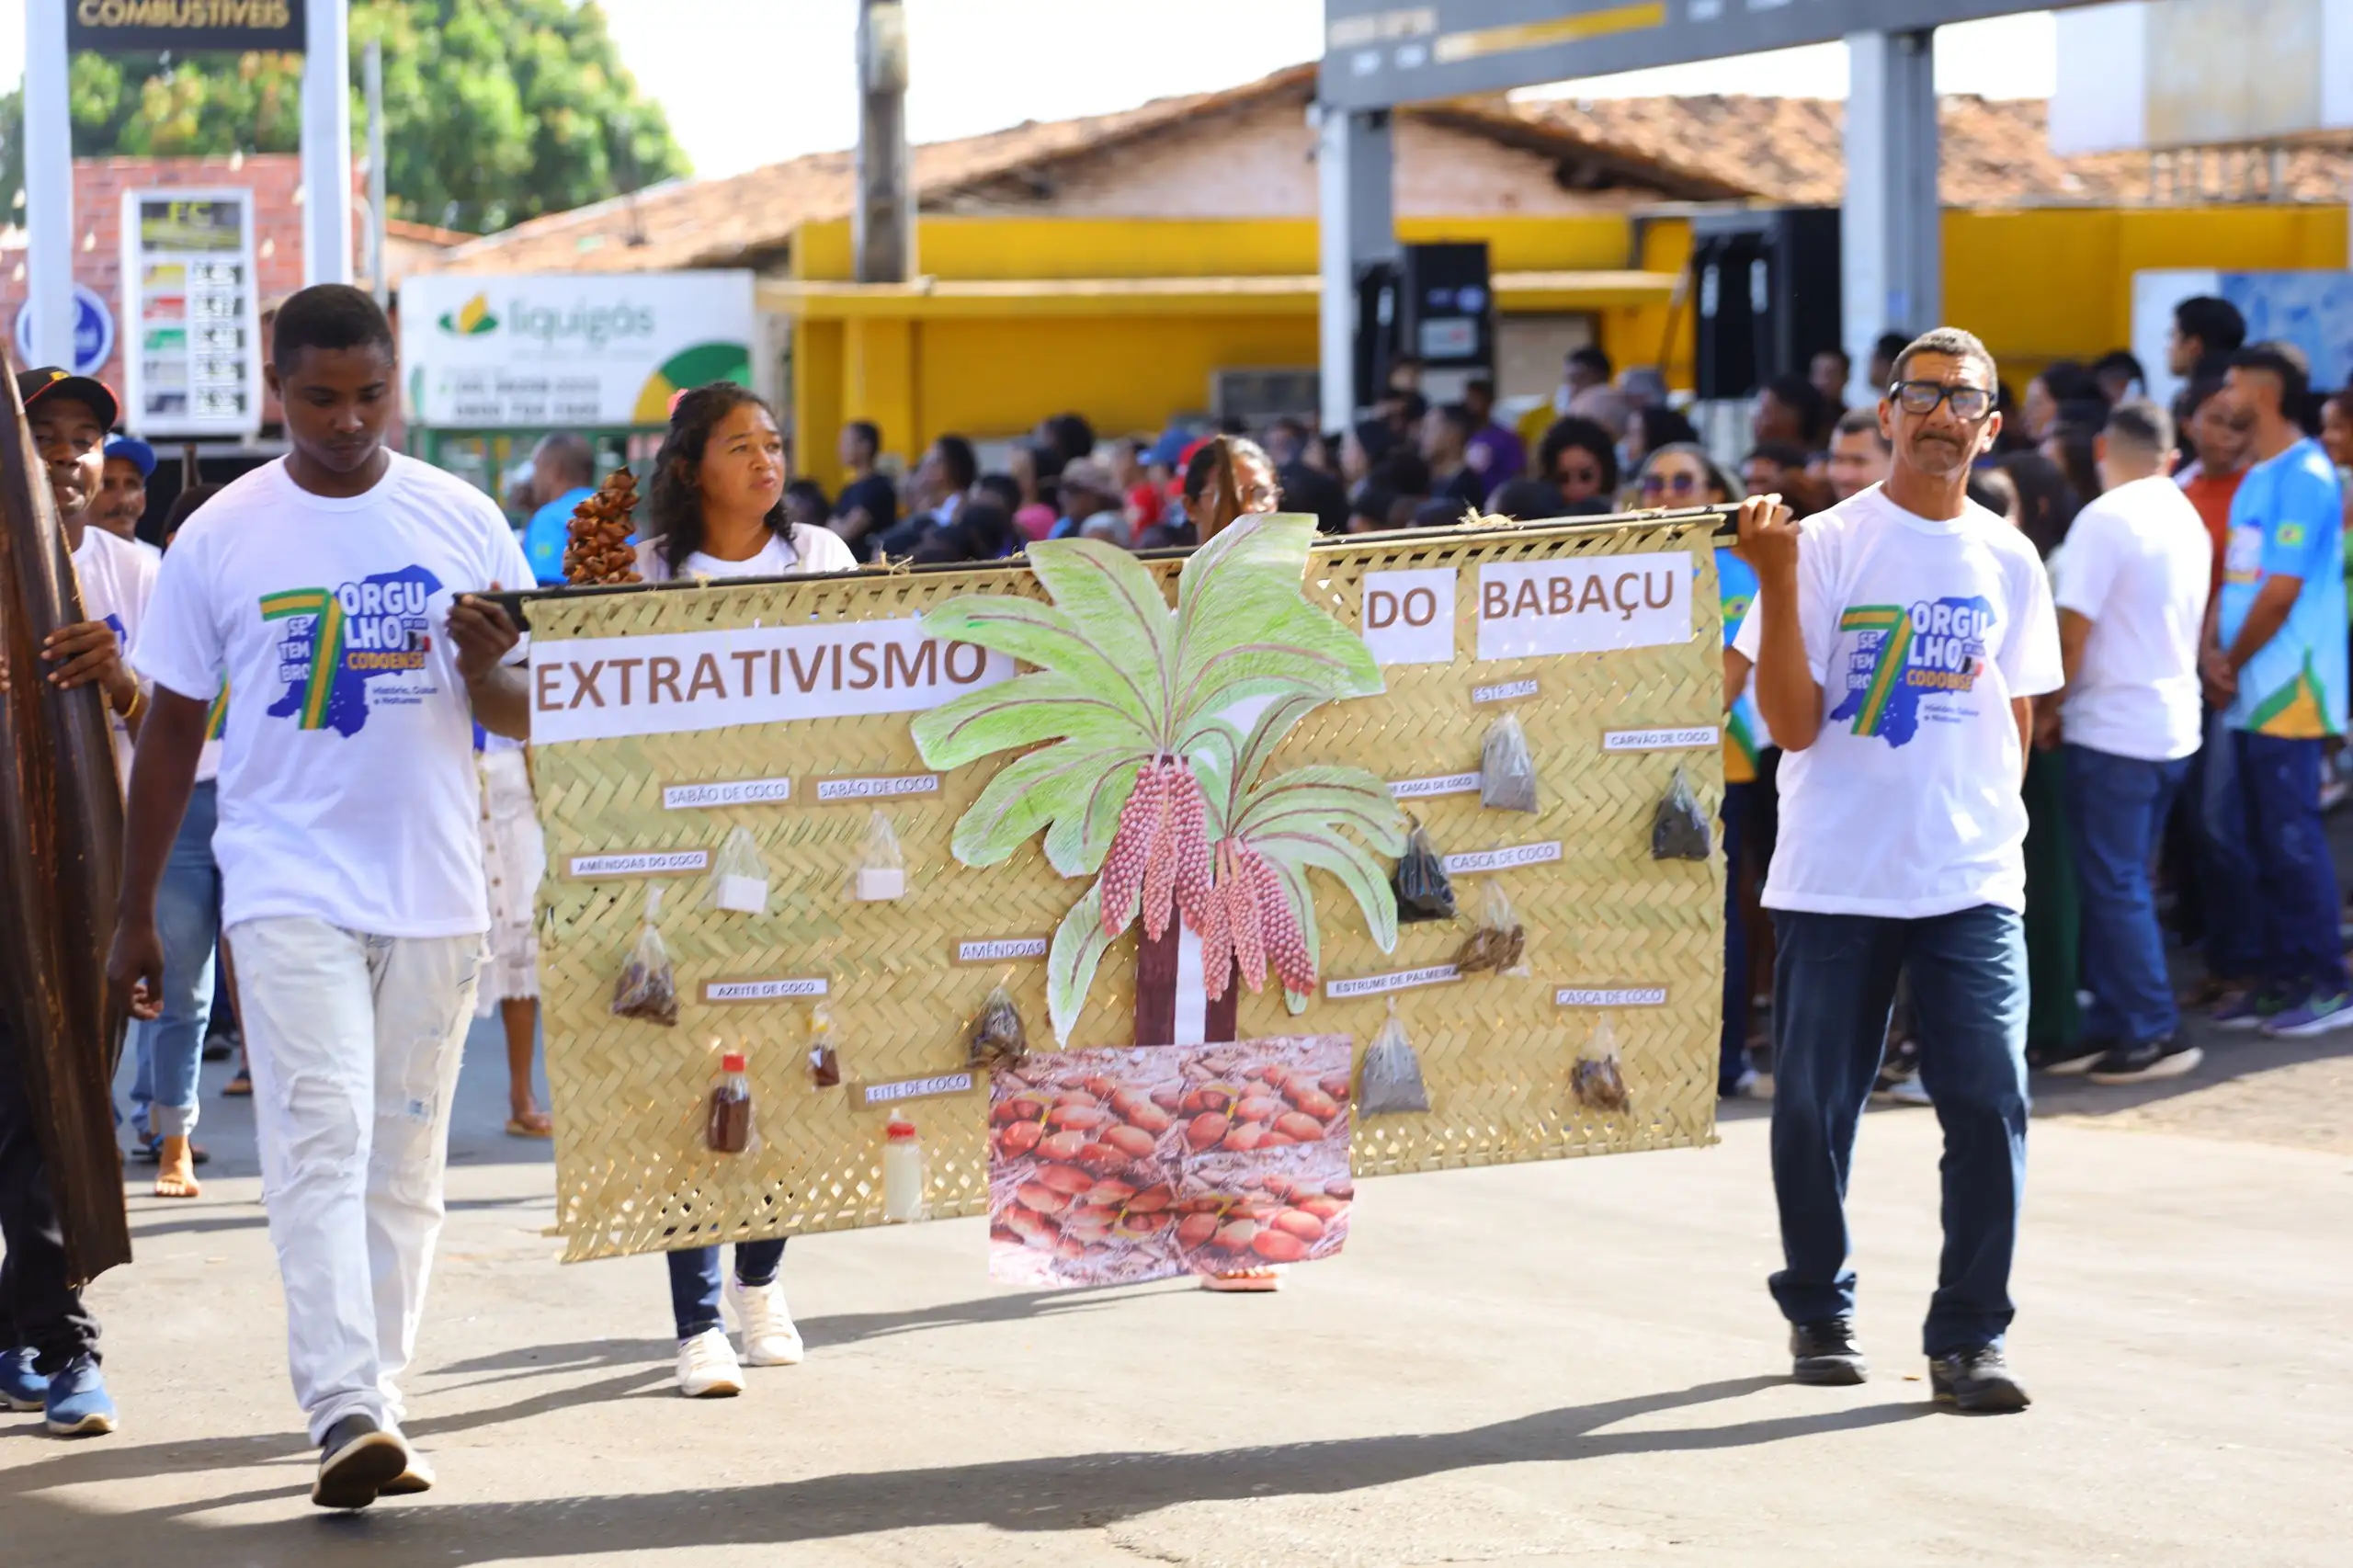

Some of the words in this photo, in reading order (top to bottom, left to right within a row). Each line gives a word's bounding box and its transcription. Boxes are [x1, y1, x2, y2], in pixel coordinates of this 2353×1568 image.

[338, 582, 426, 617] ORGU
[1367, 587, 1438, 631] DO
[1483, 570, 1674, 621] BABAÇU
[287, 617, 310, 637] SE
[1911, 600, 1988, 642] ORGU
[345, 615, 404, 650] LHO
[1859, 631, 1878, 649] SE
[278, 641, 311, 661] TEM
[1849, 652, 1876, 670] TEM
[1906, 635, 1964, 670] LHO
[278, 663, 311, 684] BRO
[536, 639, 987, 712] EXTRATIVISMO
[668, 785, 720, 804] SABÃO
[722, 786, 742, 801] DE
[744, 782, 787, 799] COCO
[819, 778, 870, 798] SABÃO
[872, 781, 893, 794] DE
[894, 776, 936, 792] COCO
[668, 853, 704, 867] COCO
[1450, 853, 1495, 869] CASCA
[1498, 850, 1515, 864] DE
[1517, 845, 1555, 861] COCO
[762, 983, 777, 994] DE
[780, 981, 815, 994] COCO
[1389, 975, 1404, 986] DE
[1558, 990, 1602, 1004] CASCA
[1624, 988, 1662, 1002] COCO
[866, 1085, 902, 1102] LEITE
[904, 1080, 923, 1096] DE
[926, 1074, 968, 1093] COCO
